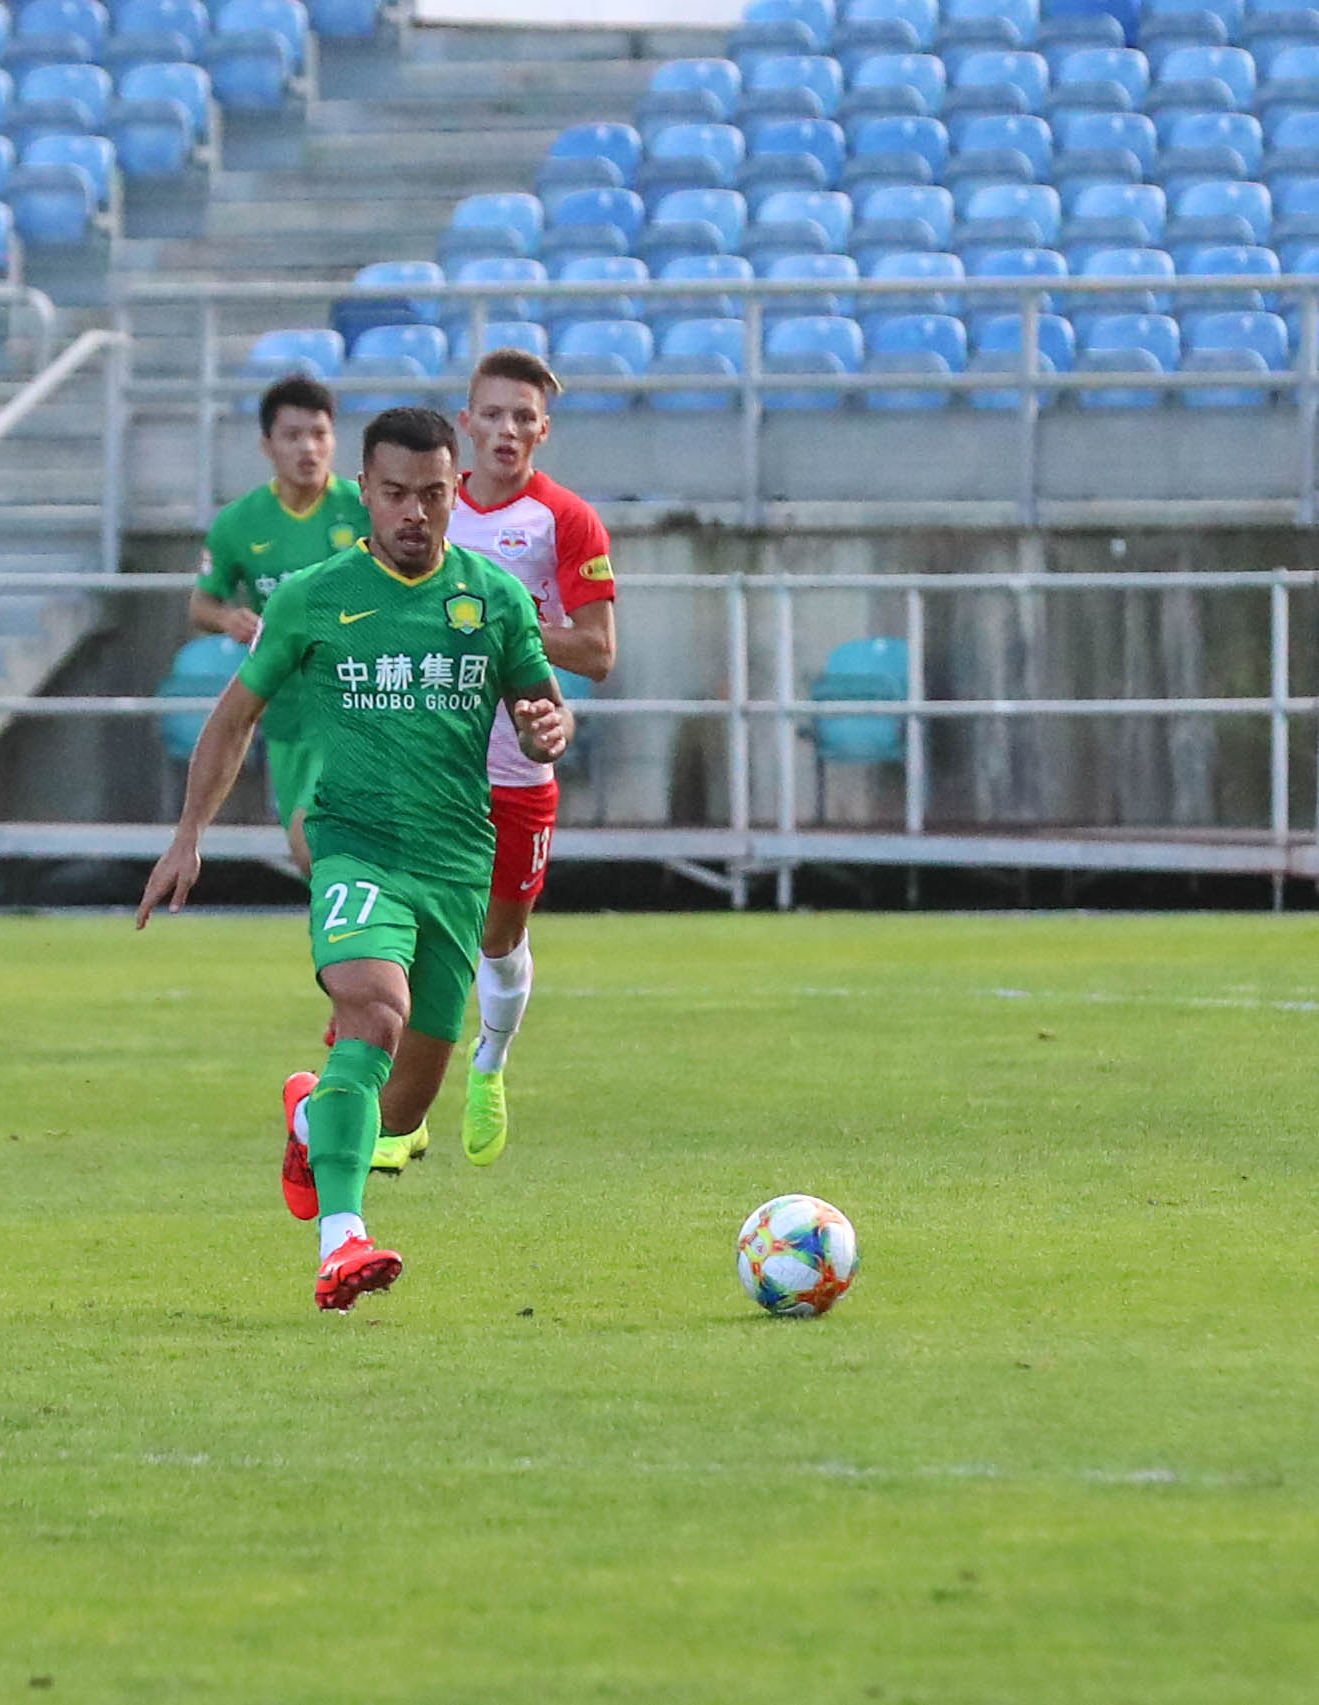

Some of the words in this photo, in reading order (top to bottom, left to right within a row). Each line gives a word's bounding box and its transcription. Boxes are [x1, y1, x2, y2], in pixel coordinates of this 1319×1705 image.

[336, 652, 489, 692] 中赫集团
[342, 692, 415, 710] SINOBO
[425, 693, 482, 710] GROUP
[323, 881, 381, 931] 27
